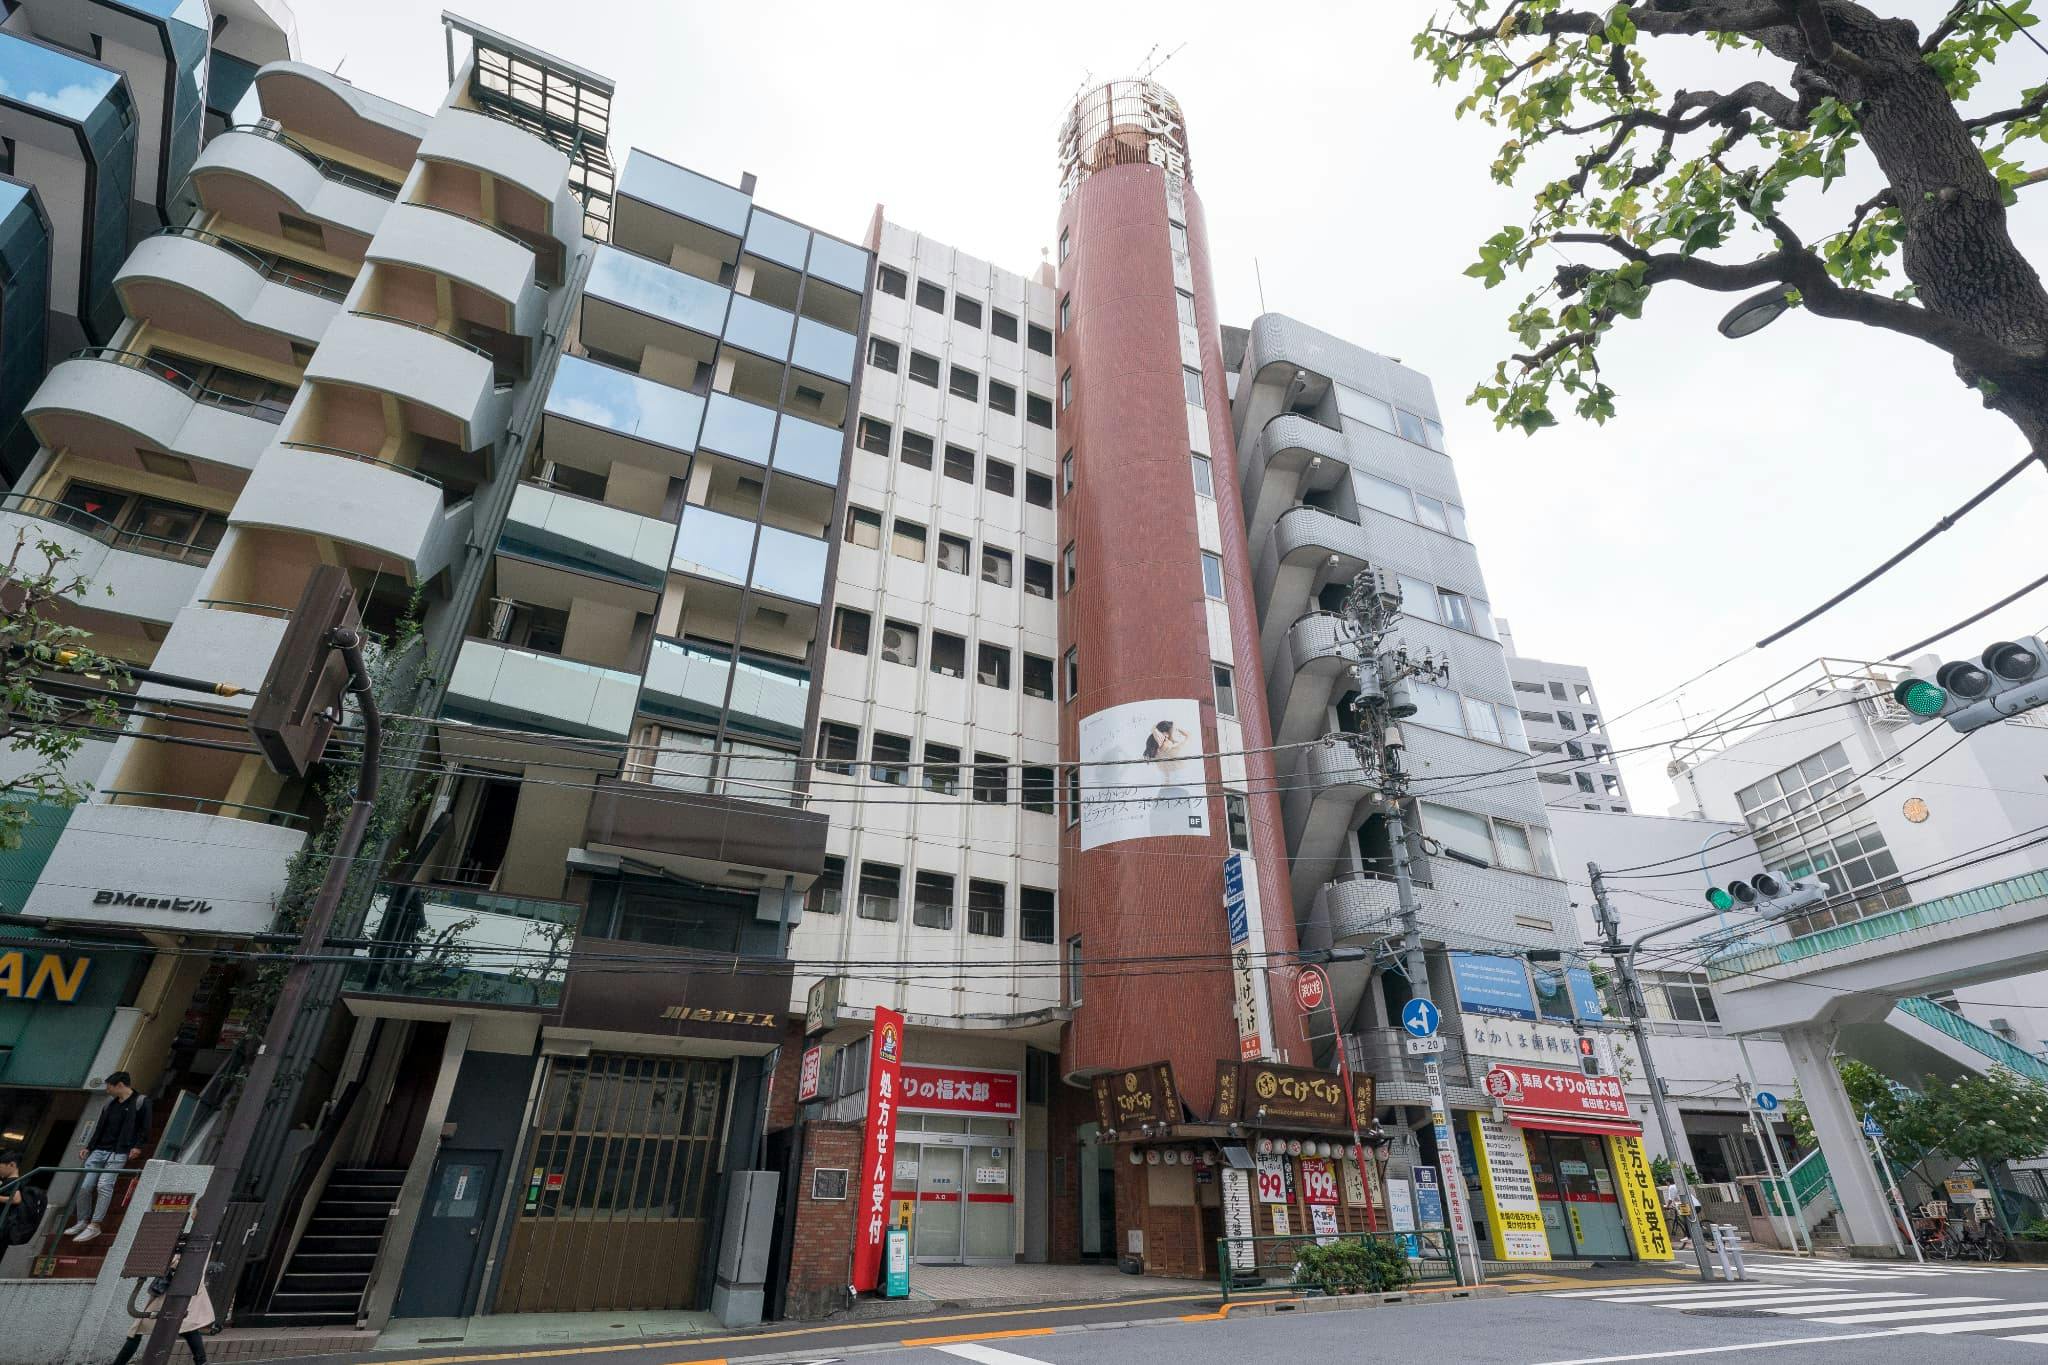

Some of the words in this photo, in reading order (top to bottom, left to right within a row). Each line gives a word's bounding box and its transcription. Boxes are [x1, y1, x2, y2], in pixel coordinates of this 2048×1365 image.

[1242, 968, 1255, 1030] てけてけ
[1301, 980, 1321, 998] 消火栓
[1474, 1026, 1577, 1055] なかしま歯科医
[898, 1076, 990, 1102] りの福太郎
[1278, 1076, 1341, 1105] てけてけ
[1489, 1073, 1511, 1097] 薬
[1521, 1073, 1543, 1089] 薬局
[1544, 1075, 1621, 1098] くすりの福太郎
[1117, 1091, 1152, 1112] てけてけ
[1581, 1097, 1625, 1112] 飯田橋2号店
[868, 1069, 893, 1245] 処方せん受付
[1259, 1174, 1281, 1198] 99
[1303, 1171, 1332, 1198] 199
[1625, 1136, 1666, 1255] 処方せん受付
